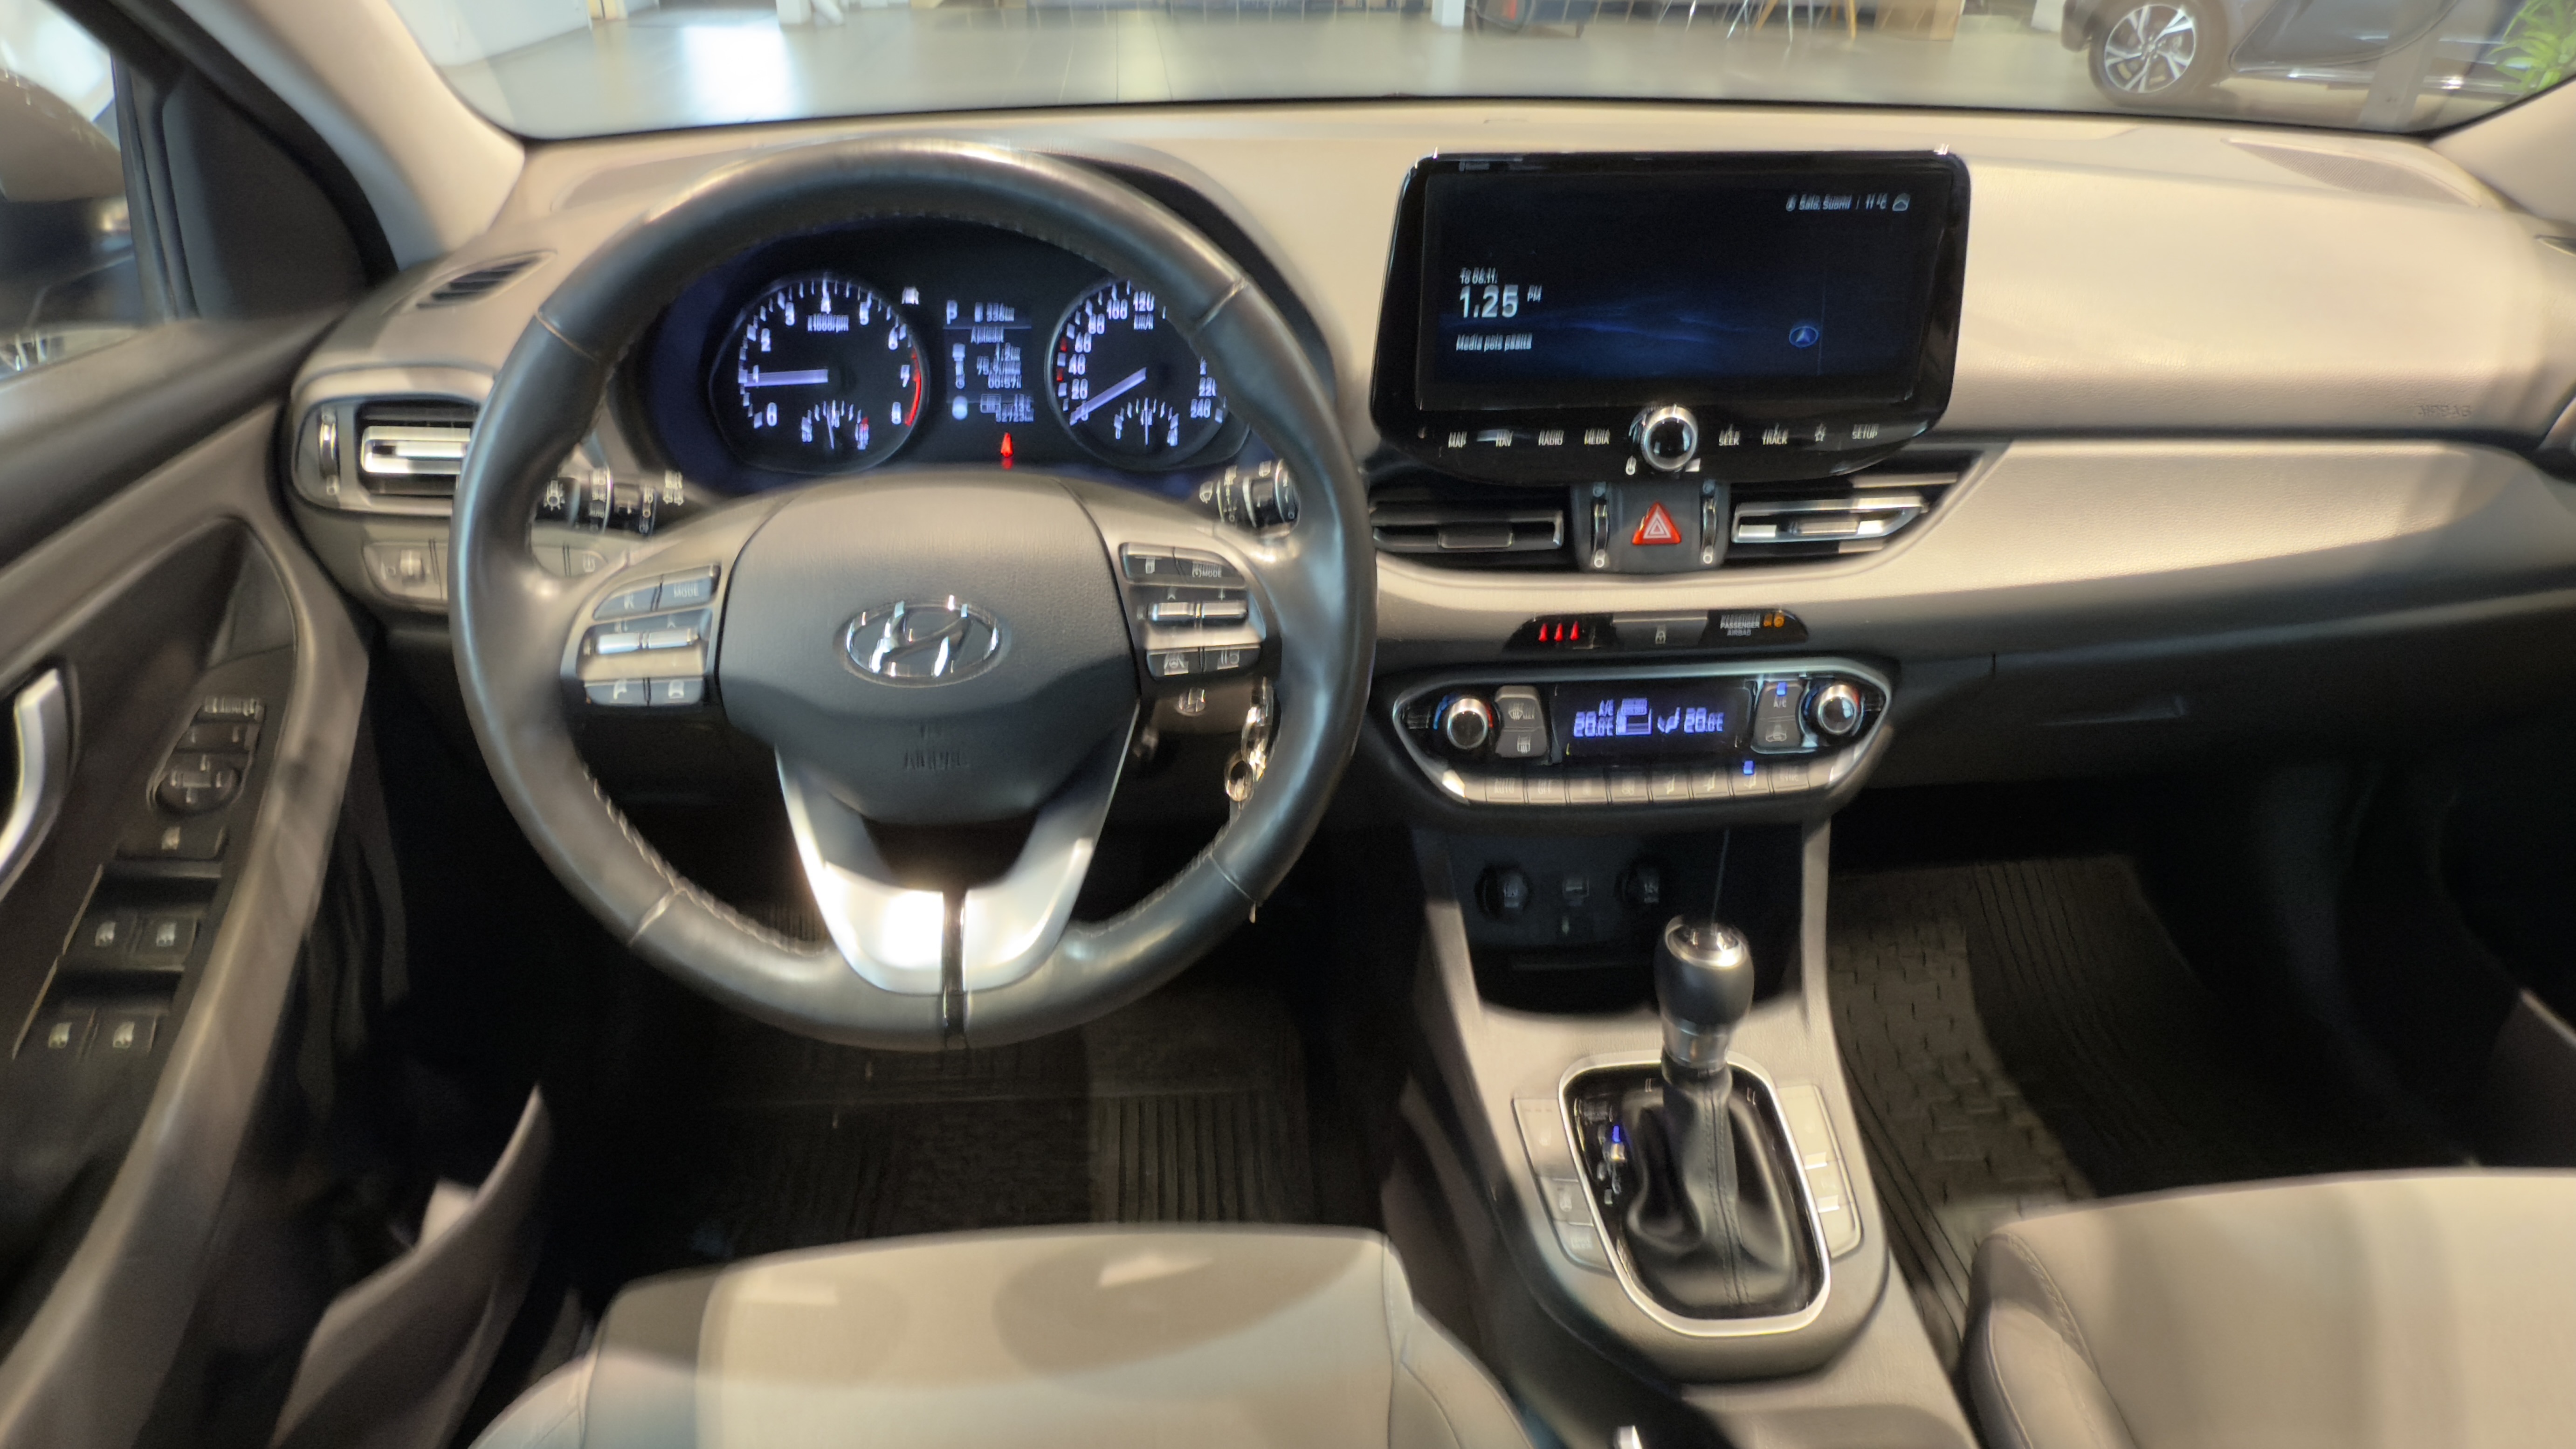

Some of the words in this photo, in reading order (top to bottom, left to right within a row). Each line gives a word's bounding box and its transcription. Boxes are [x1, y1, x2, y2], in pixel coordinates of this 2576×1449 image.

[1107, 299, 1128, 319] 100
[1460, 284, 1518, 318] 1.25
[1528, 285, 1542, 302] PM
[785, 302, 795, 325] 3
[946, 300, 958, 324] P
[1088, 313, 1105, 334] 80
[761, 328, 771, 352] 2
[1075, 332, 1092, 353] 60
[1068, 354, 1086, 375] 40
[1071, 378, 1088, 400] 20
[766, 401, 778, 426] 0
[1191, 399, 1211, 418] 240
[1448, 432, 1467, 448] MAP
[1496, 431, 1513, 447] NAV
[1539, 430, 1564, 446] RADIO
[1584, 429, 1610, 445] MEDIA
[1763, 429, 1789, 445] TRACK
[1852, 424, 1879, 440] SETUP
[1203, 563, 1221, 578] MODE
[674, 583, 699, 598] MODE
[1720, 614, 1760, 629] PASSENGER
